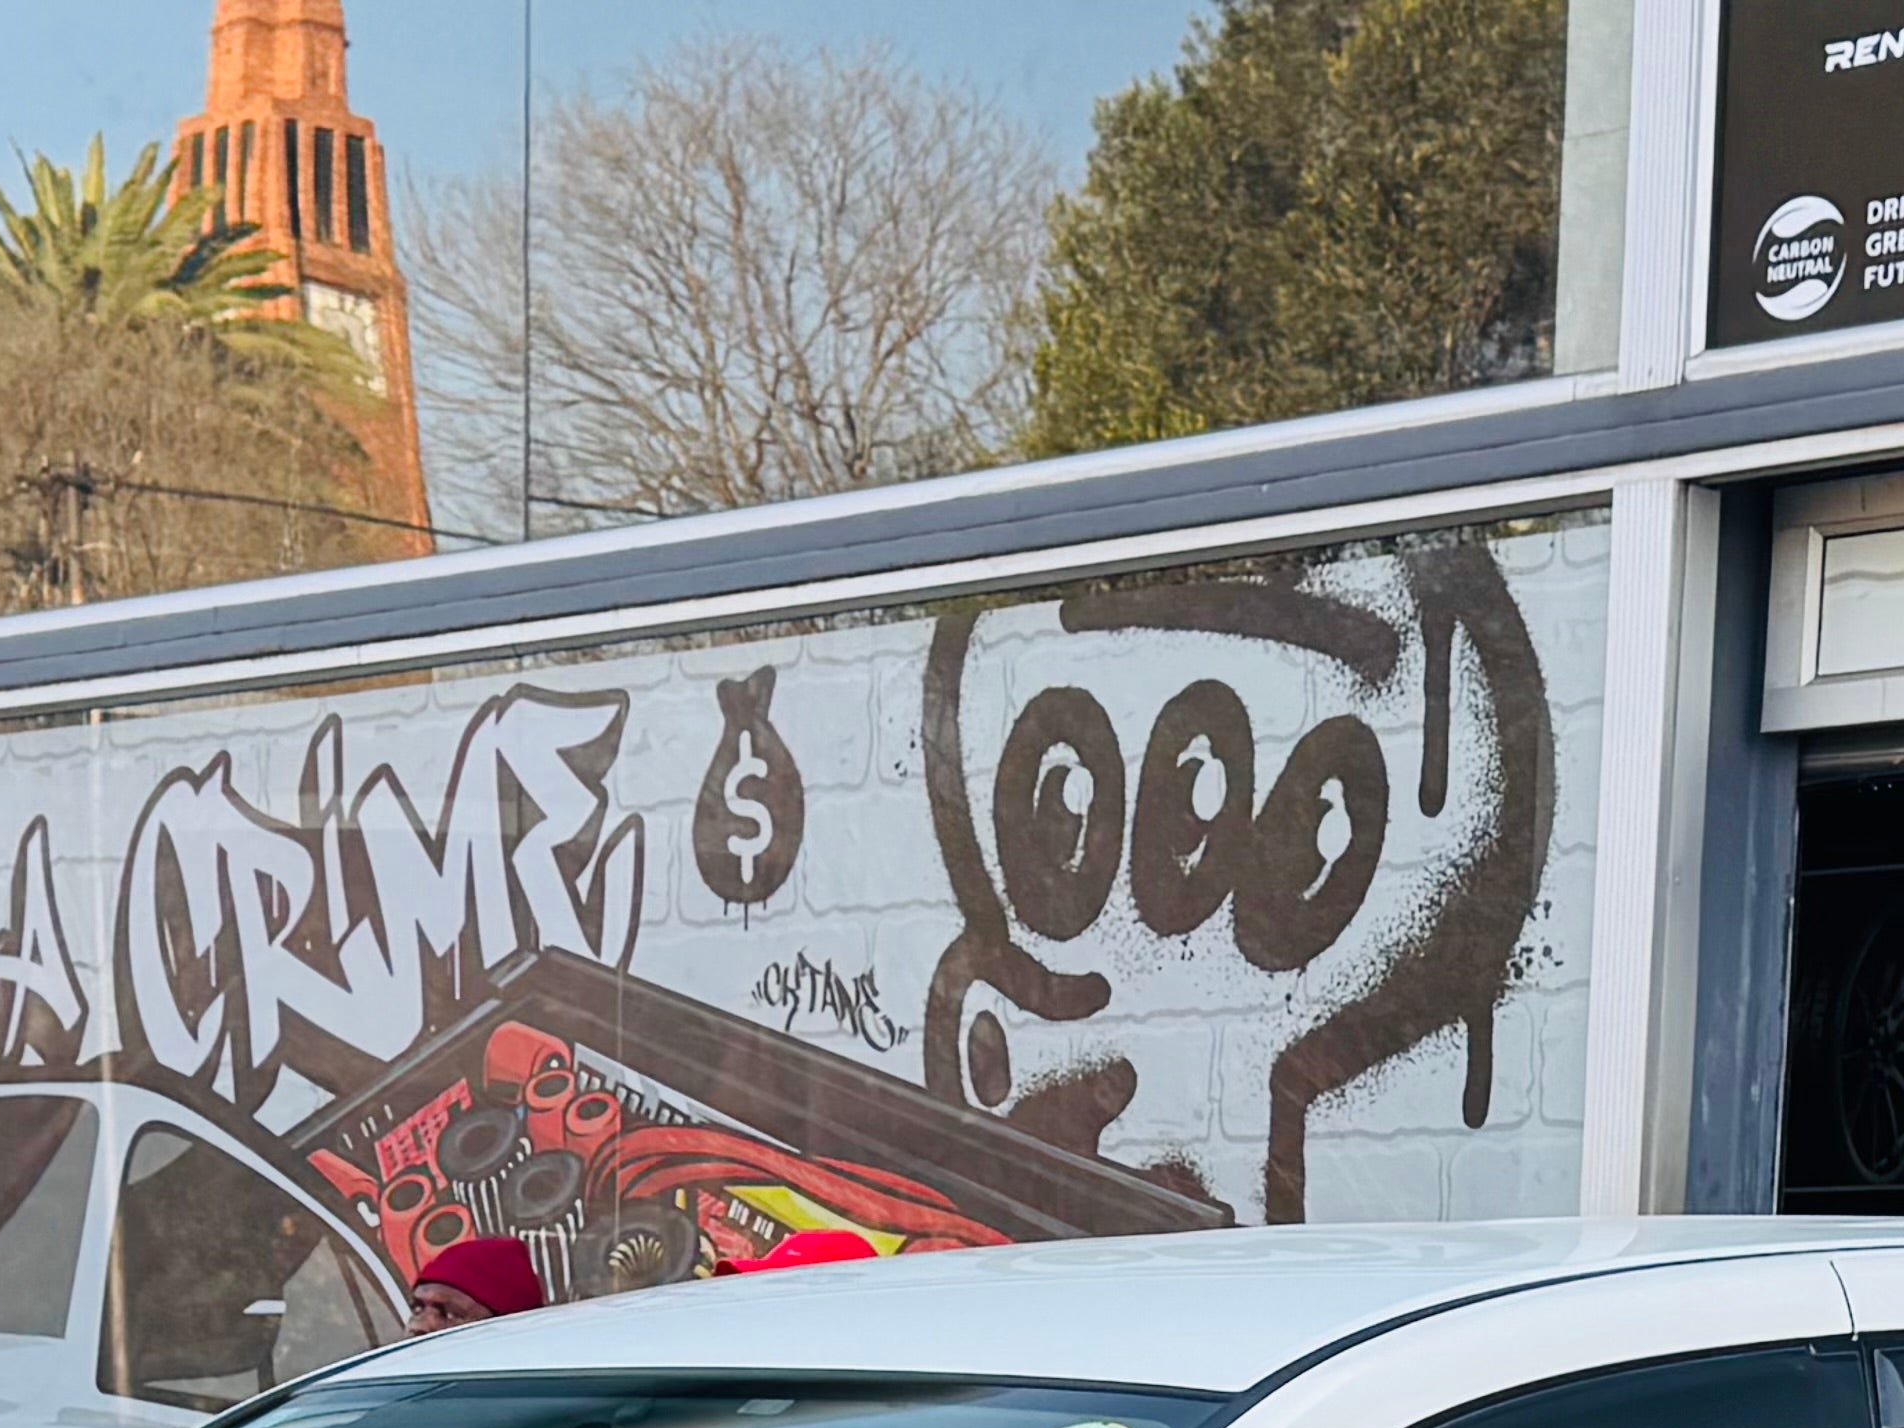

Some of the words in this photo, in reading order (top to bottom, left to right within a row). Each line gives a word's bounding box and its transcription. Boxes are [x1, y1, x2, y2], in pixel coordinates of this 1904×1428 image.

[1768, 236, 1834, 263] CARBON
[1767, 256, 1833, 284] NEUTRAL
[114, 683, 646, 1120] CRIME
